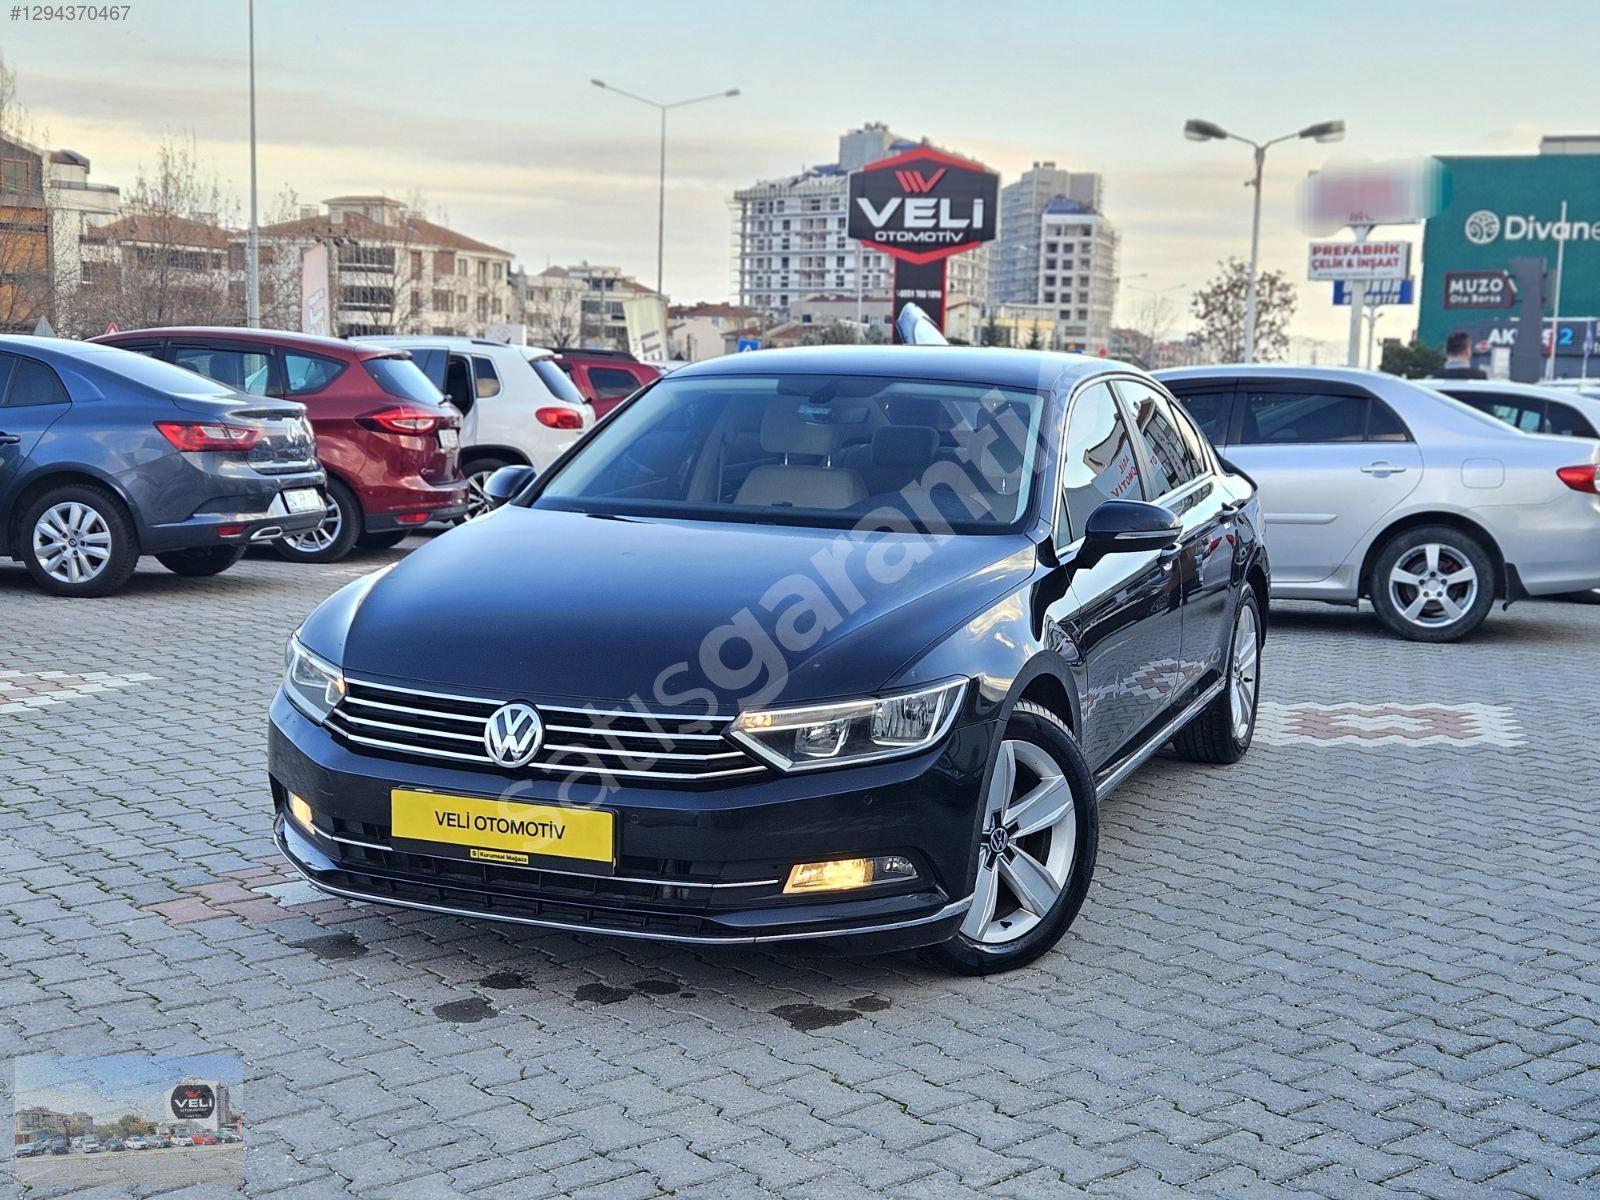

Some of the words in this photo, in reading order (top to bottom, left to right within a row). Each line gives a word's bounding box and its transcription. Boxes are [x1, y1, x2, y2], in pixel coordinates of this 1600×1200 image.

[875, 229, 964, 242] OTOMOTİV
[1312, 243, 1400, 256] PREFABRİK
[1312, 257, 1344, 270] ÇELİK
[1346, 258, 1354, 268] &
[1357, 256, 1400, 270] İNŞAAT
[1449, 278, 1504, 293] MUZO
[1559, 328, 1573, 345] 2
[434, 811, 470, 829] VELİ
[474, 815, 566, 840] OTOMOTİV
[479, 851, 505, 860] Kurumsal
